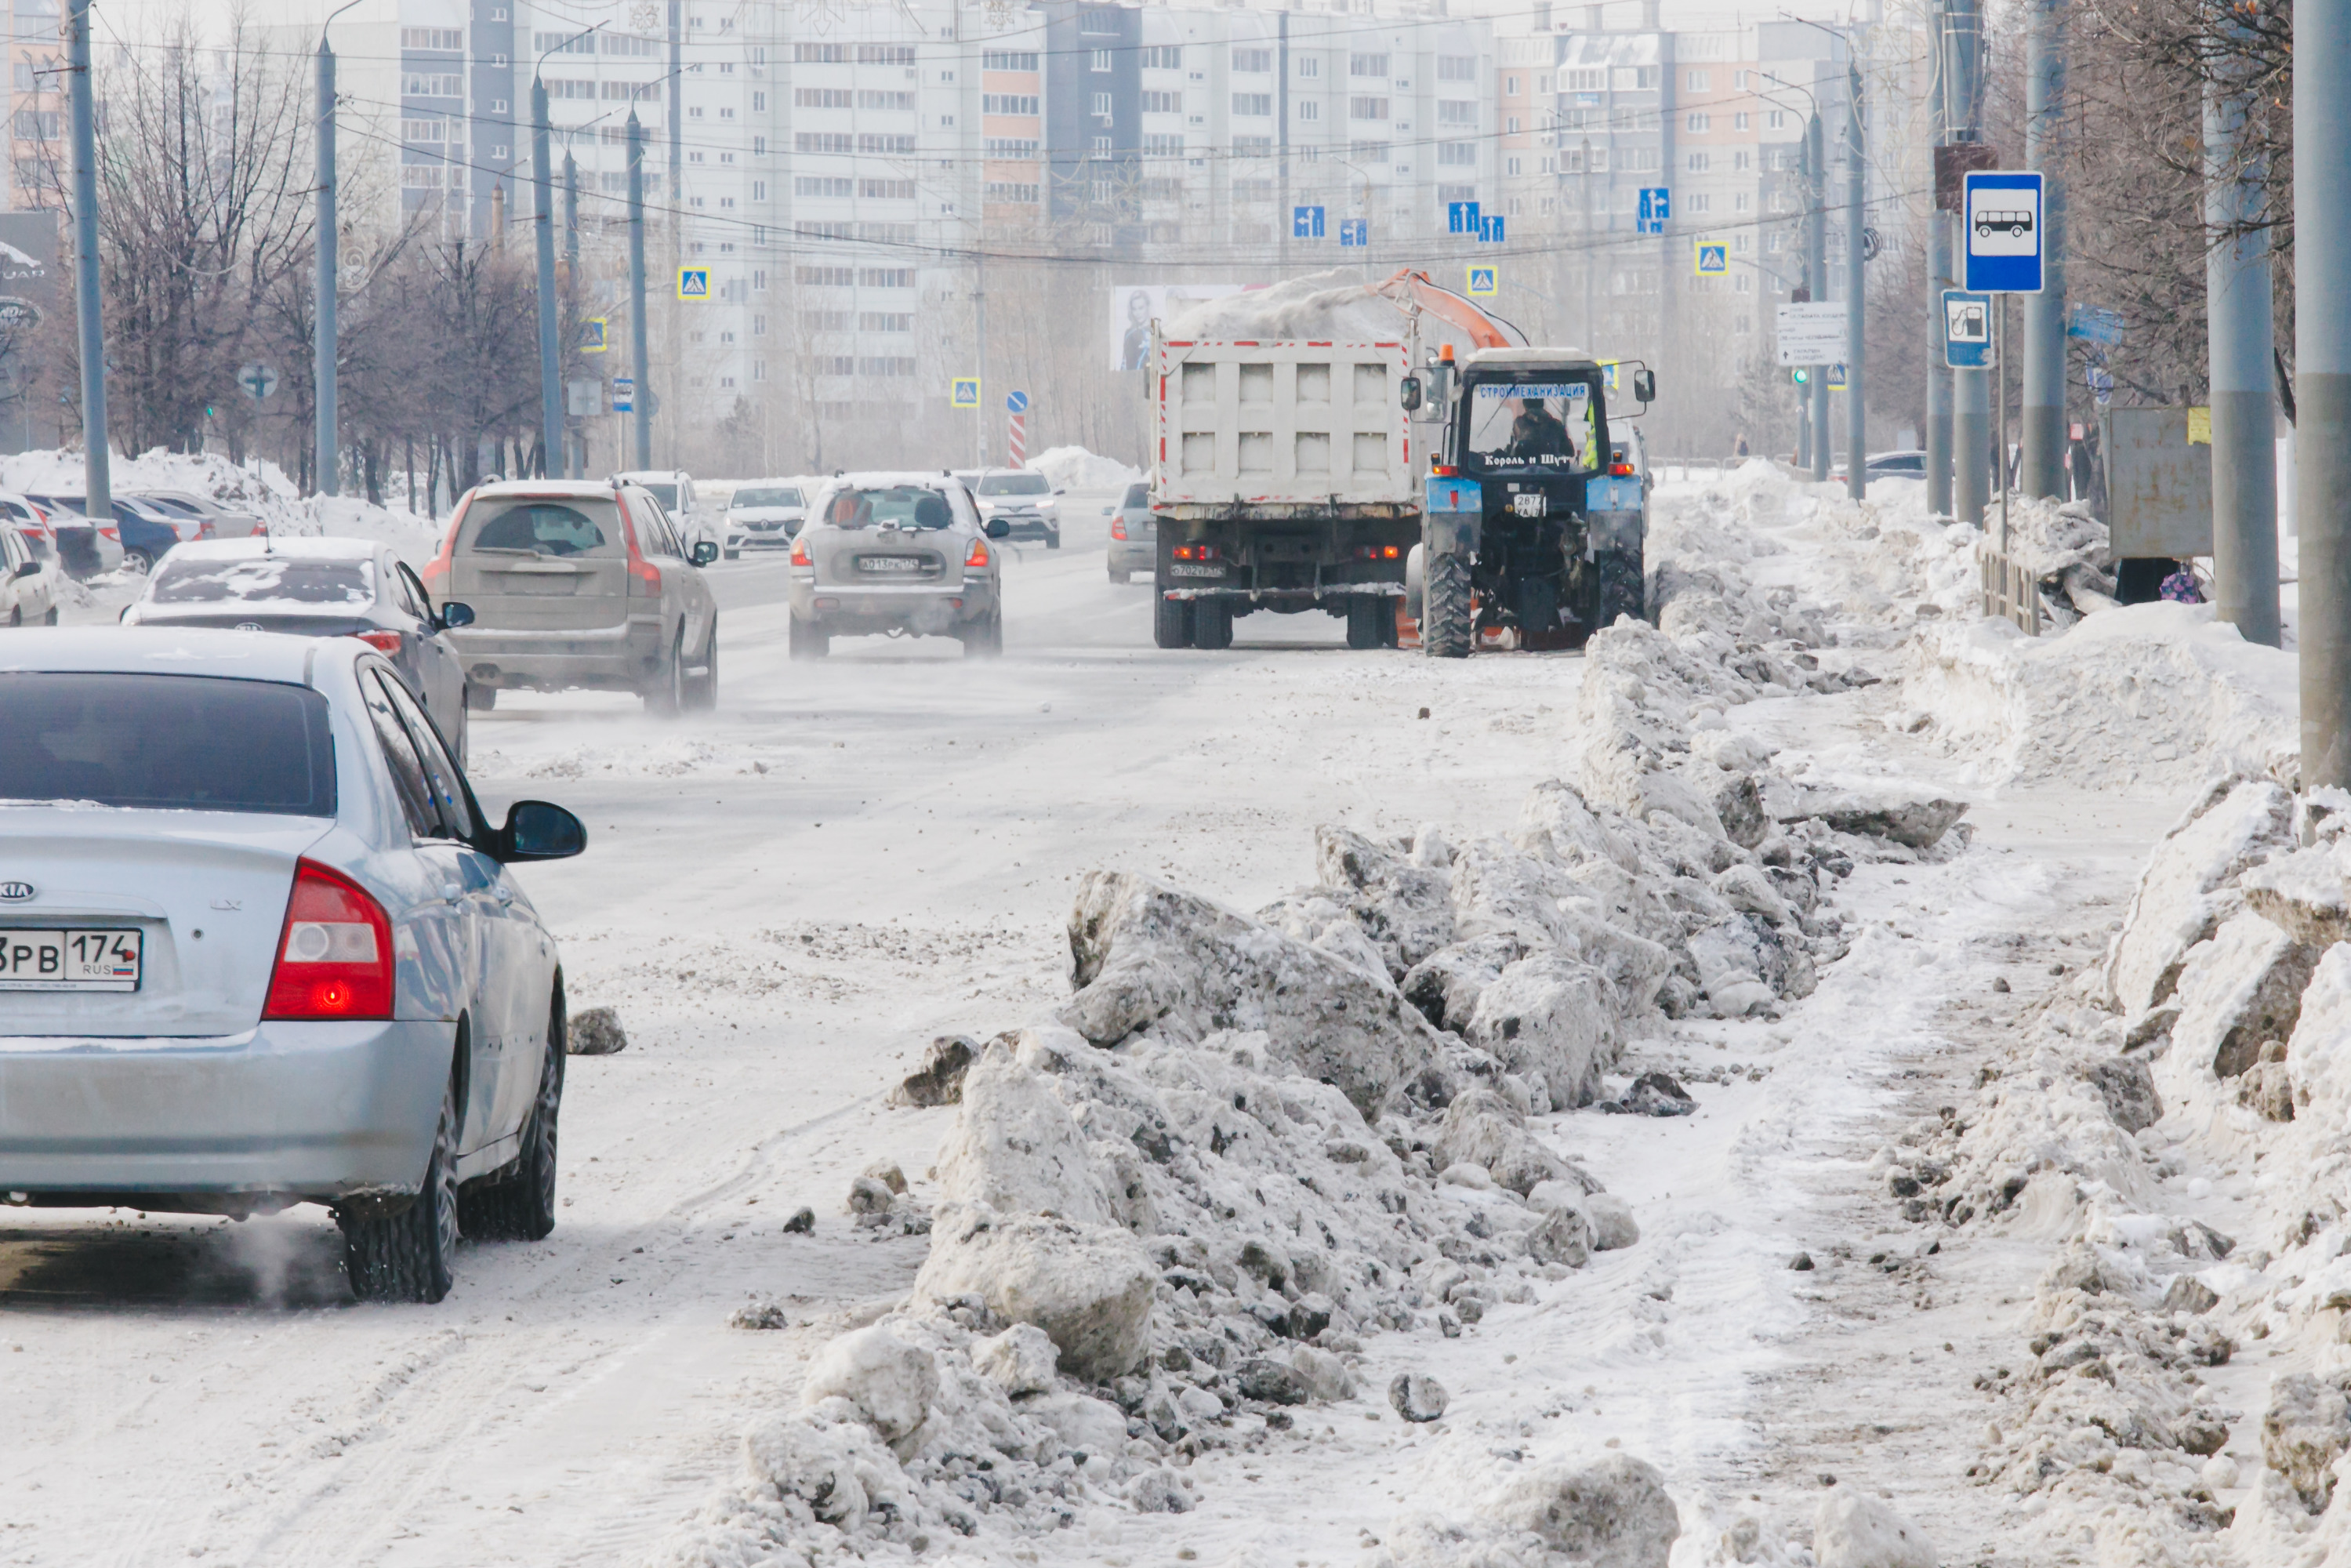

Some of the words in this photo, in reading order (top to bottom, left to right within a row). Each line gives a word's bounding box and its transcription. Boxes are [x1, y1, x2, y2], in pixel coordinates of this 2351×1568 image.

[1485, 456, 1524, 466] Король
[1541, 454, 1569, 466] Шут
[0, 884, 29, 896] KIA
[71, 935, 136, 963] 174
[83, 964, 111, 975] RUS
